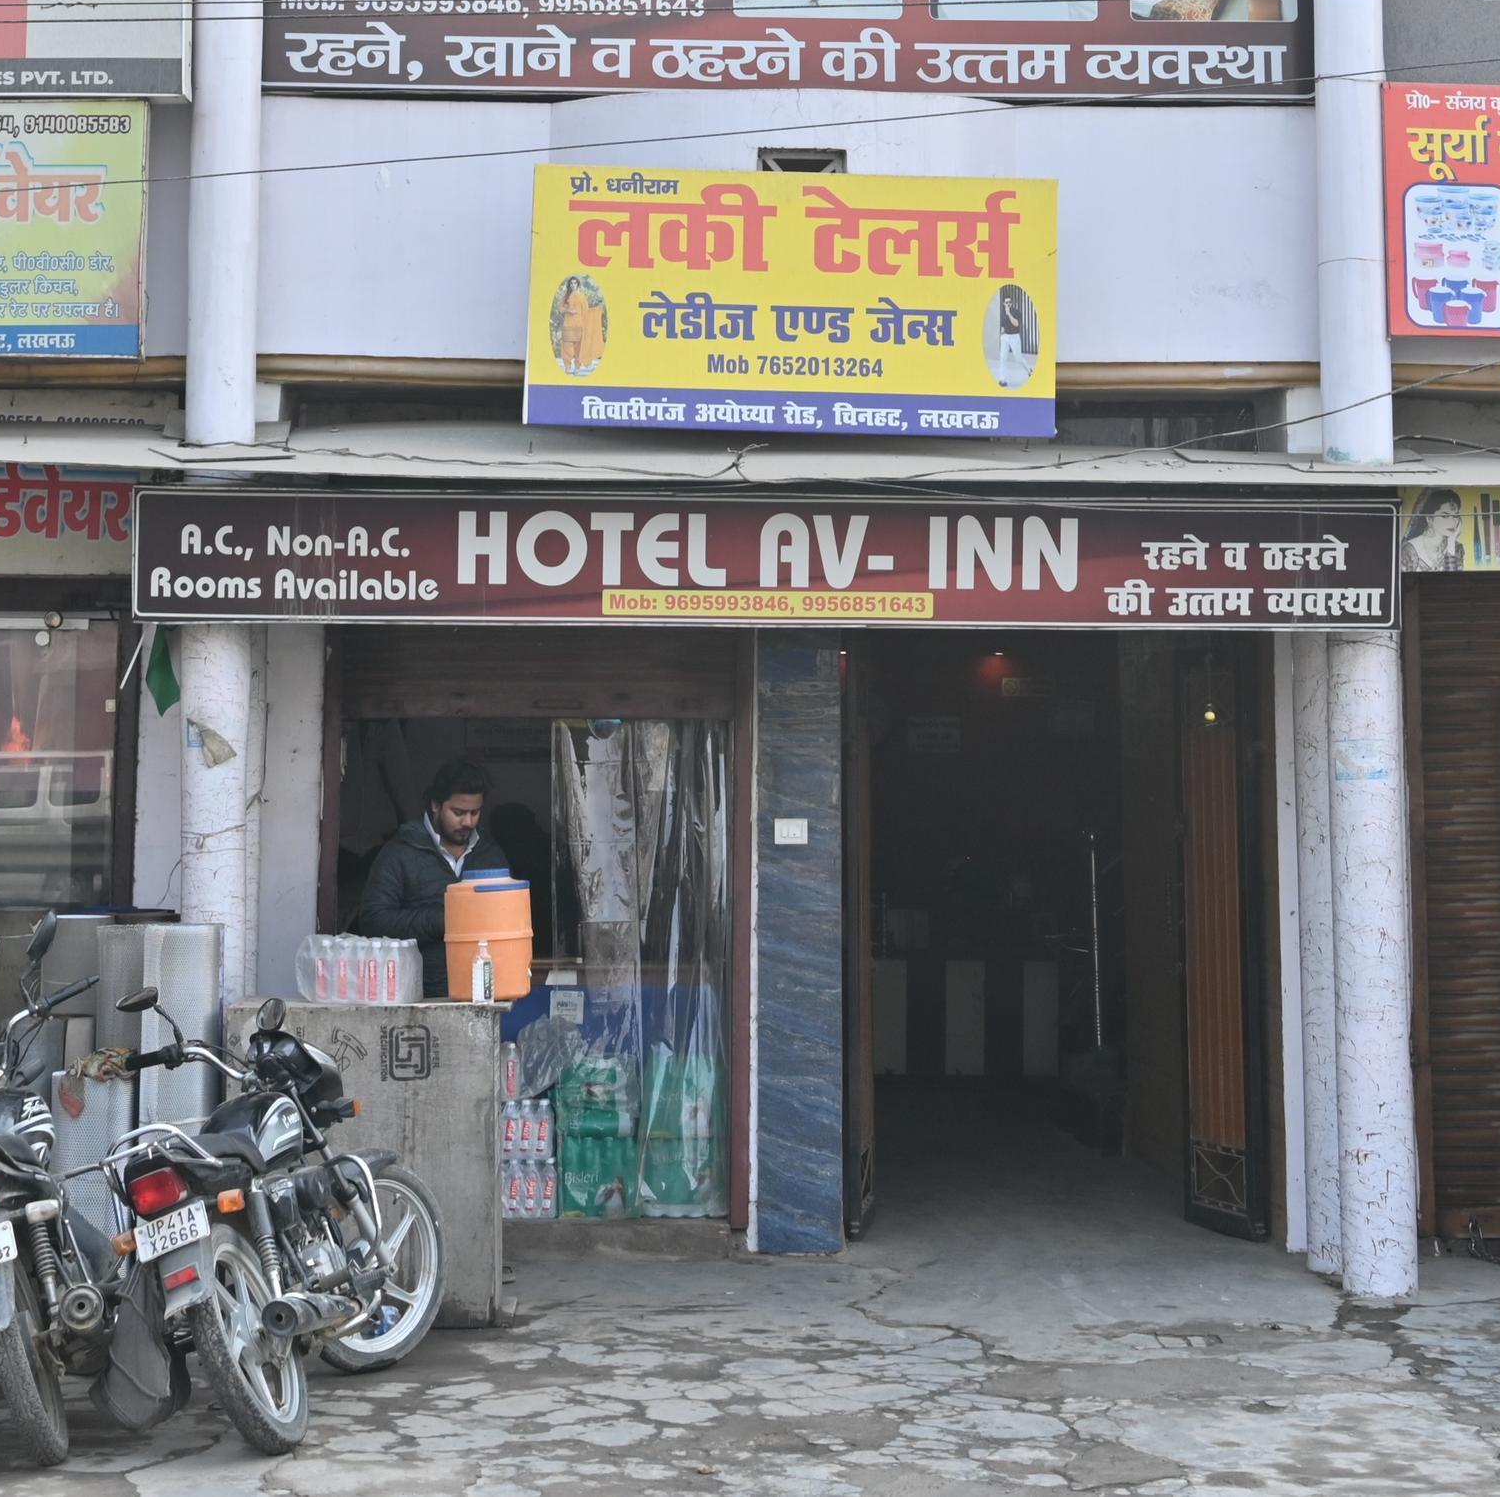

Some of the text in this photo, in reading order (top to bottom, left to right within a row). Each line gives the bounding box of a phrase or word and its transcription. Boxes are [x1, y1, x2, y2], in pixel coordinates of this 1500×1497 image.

[285, 21, 1284, 86] रहने, खाने व ठहरने की उत्तम व्यवस्था
[21, 71, 63, 85] PVT.
[70, 71, 113, 85] LTD.
[1406, 115, 1488, 180] सूर्या
[606, 172, 679, 195] धनीराम
[569, 184, 1020, 279] लकी टेलर्स
[639, 291, 957, 346] लेडीज एण्ड जेन्स
[708, 355, 883, 378] Mob 7652013264
[582, 396, 685, 421] तिवारीगंज
[695, 403, 774, 424] अयोध्या
[918, 409, 999, 430] लखनऊ
[181, 524, 410, 561] A.C., Non-A.C.
[458, 510, 726, 587] HOTEL
[928, 514, 1079, 592] INN
[150, 567, 439, 602] Rooms Available
[146, 1210, 195, 1238] UP41A
[151, 1224, 199, 1255] X2666
